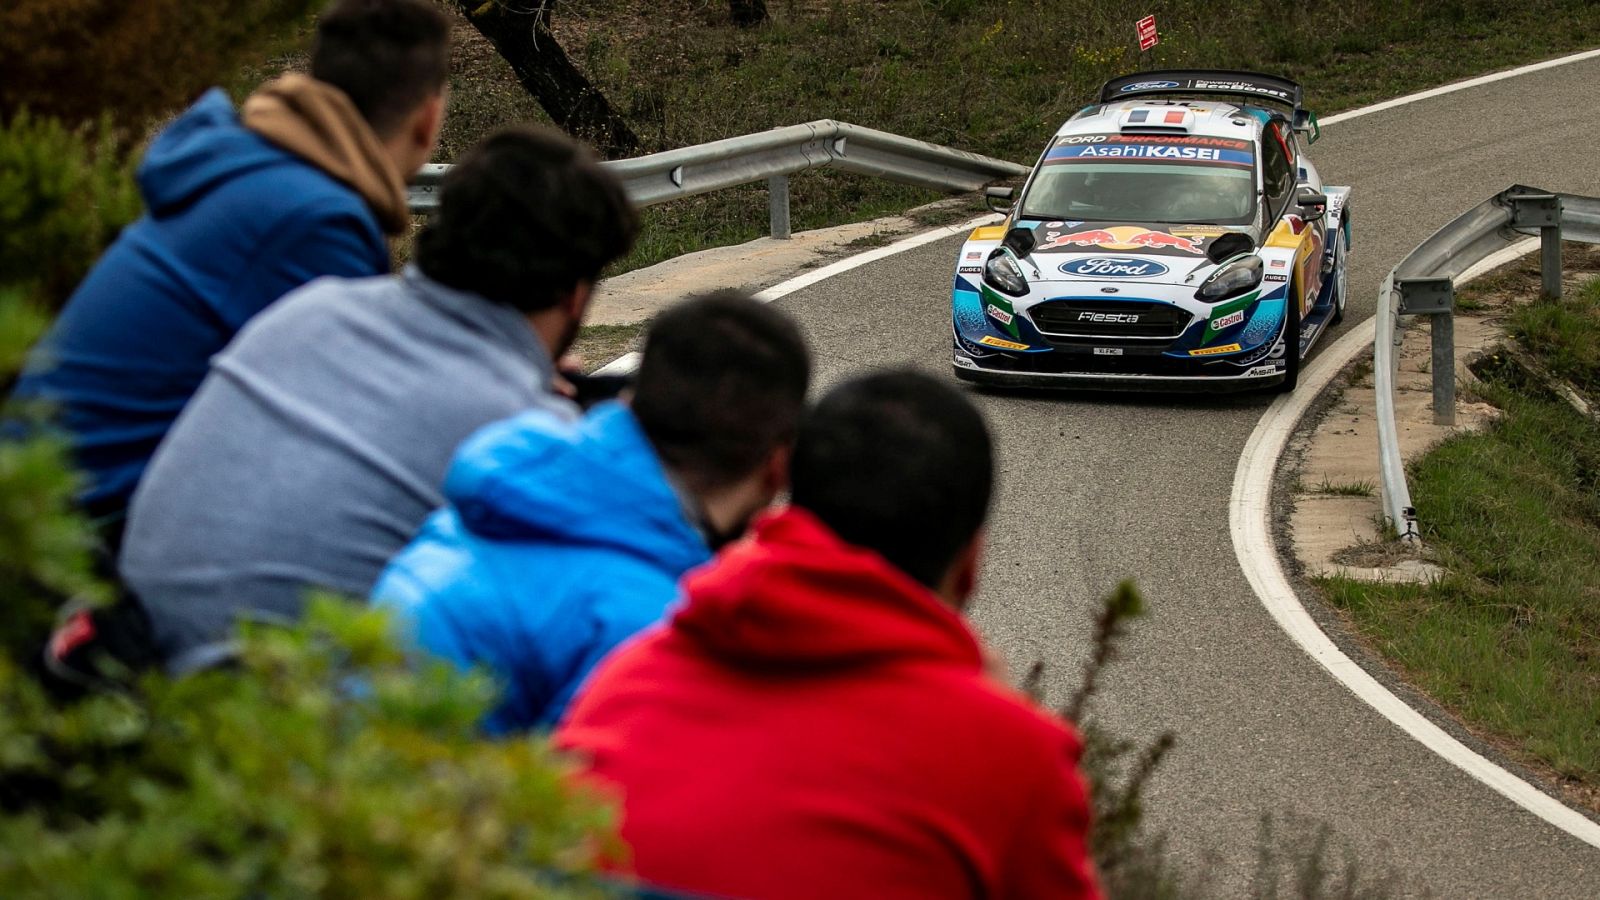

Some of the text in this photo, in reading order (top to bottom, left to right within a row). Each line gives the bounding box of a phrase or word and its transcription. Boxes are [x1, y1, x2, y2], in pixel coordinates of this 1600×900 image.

[1195, 83, 1288, 98] EcoBoost
[1058, 135, 1249, 149] FORD PERFORMANCE
[1077, 258, 1150, 276] Ford
[992, 307, 1011, 323] Castrol
[1219, 311, 1243, 327] Castrol
